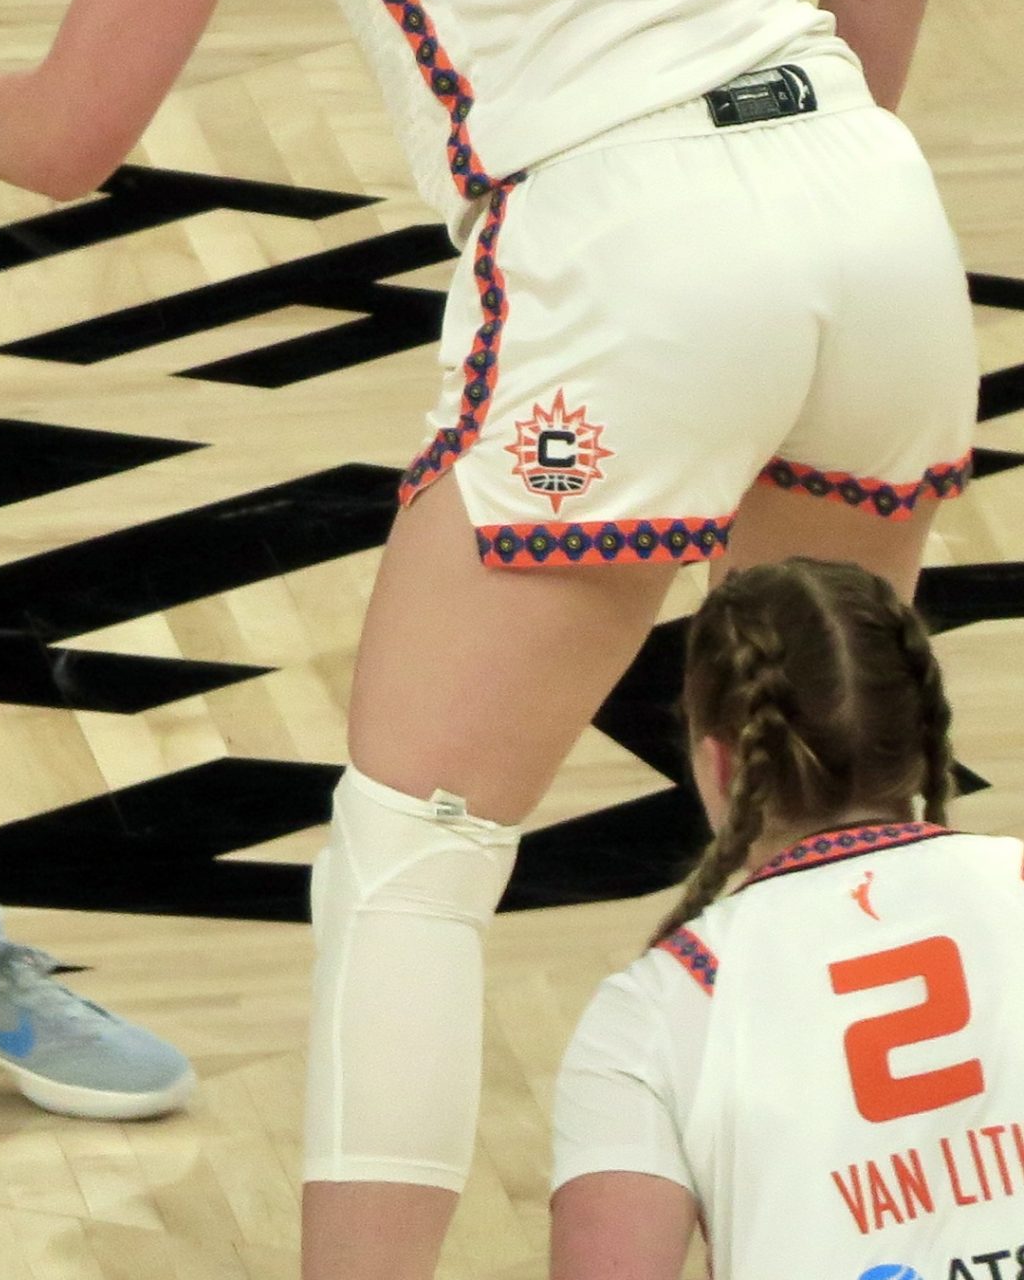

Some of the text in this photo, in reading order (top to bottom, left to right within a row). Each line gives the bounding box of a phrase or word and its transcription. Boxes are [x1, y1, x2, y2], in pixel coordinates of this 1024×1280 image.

[538, 430, 576, 468] C
[827, 935, 986, 1123] 2
[830, 1148, 936, 1235] VAN
